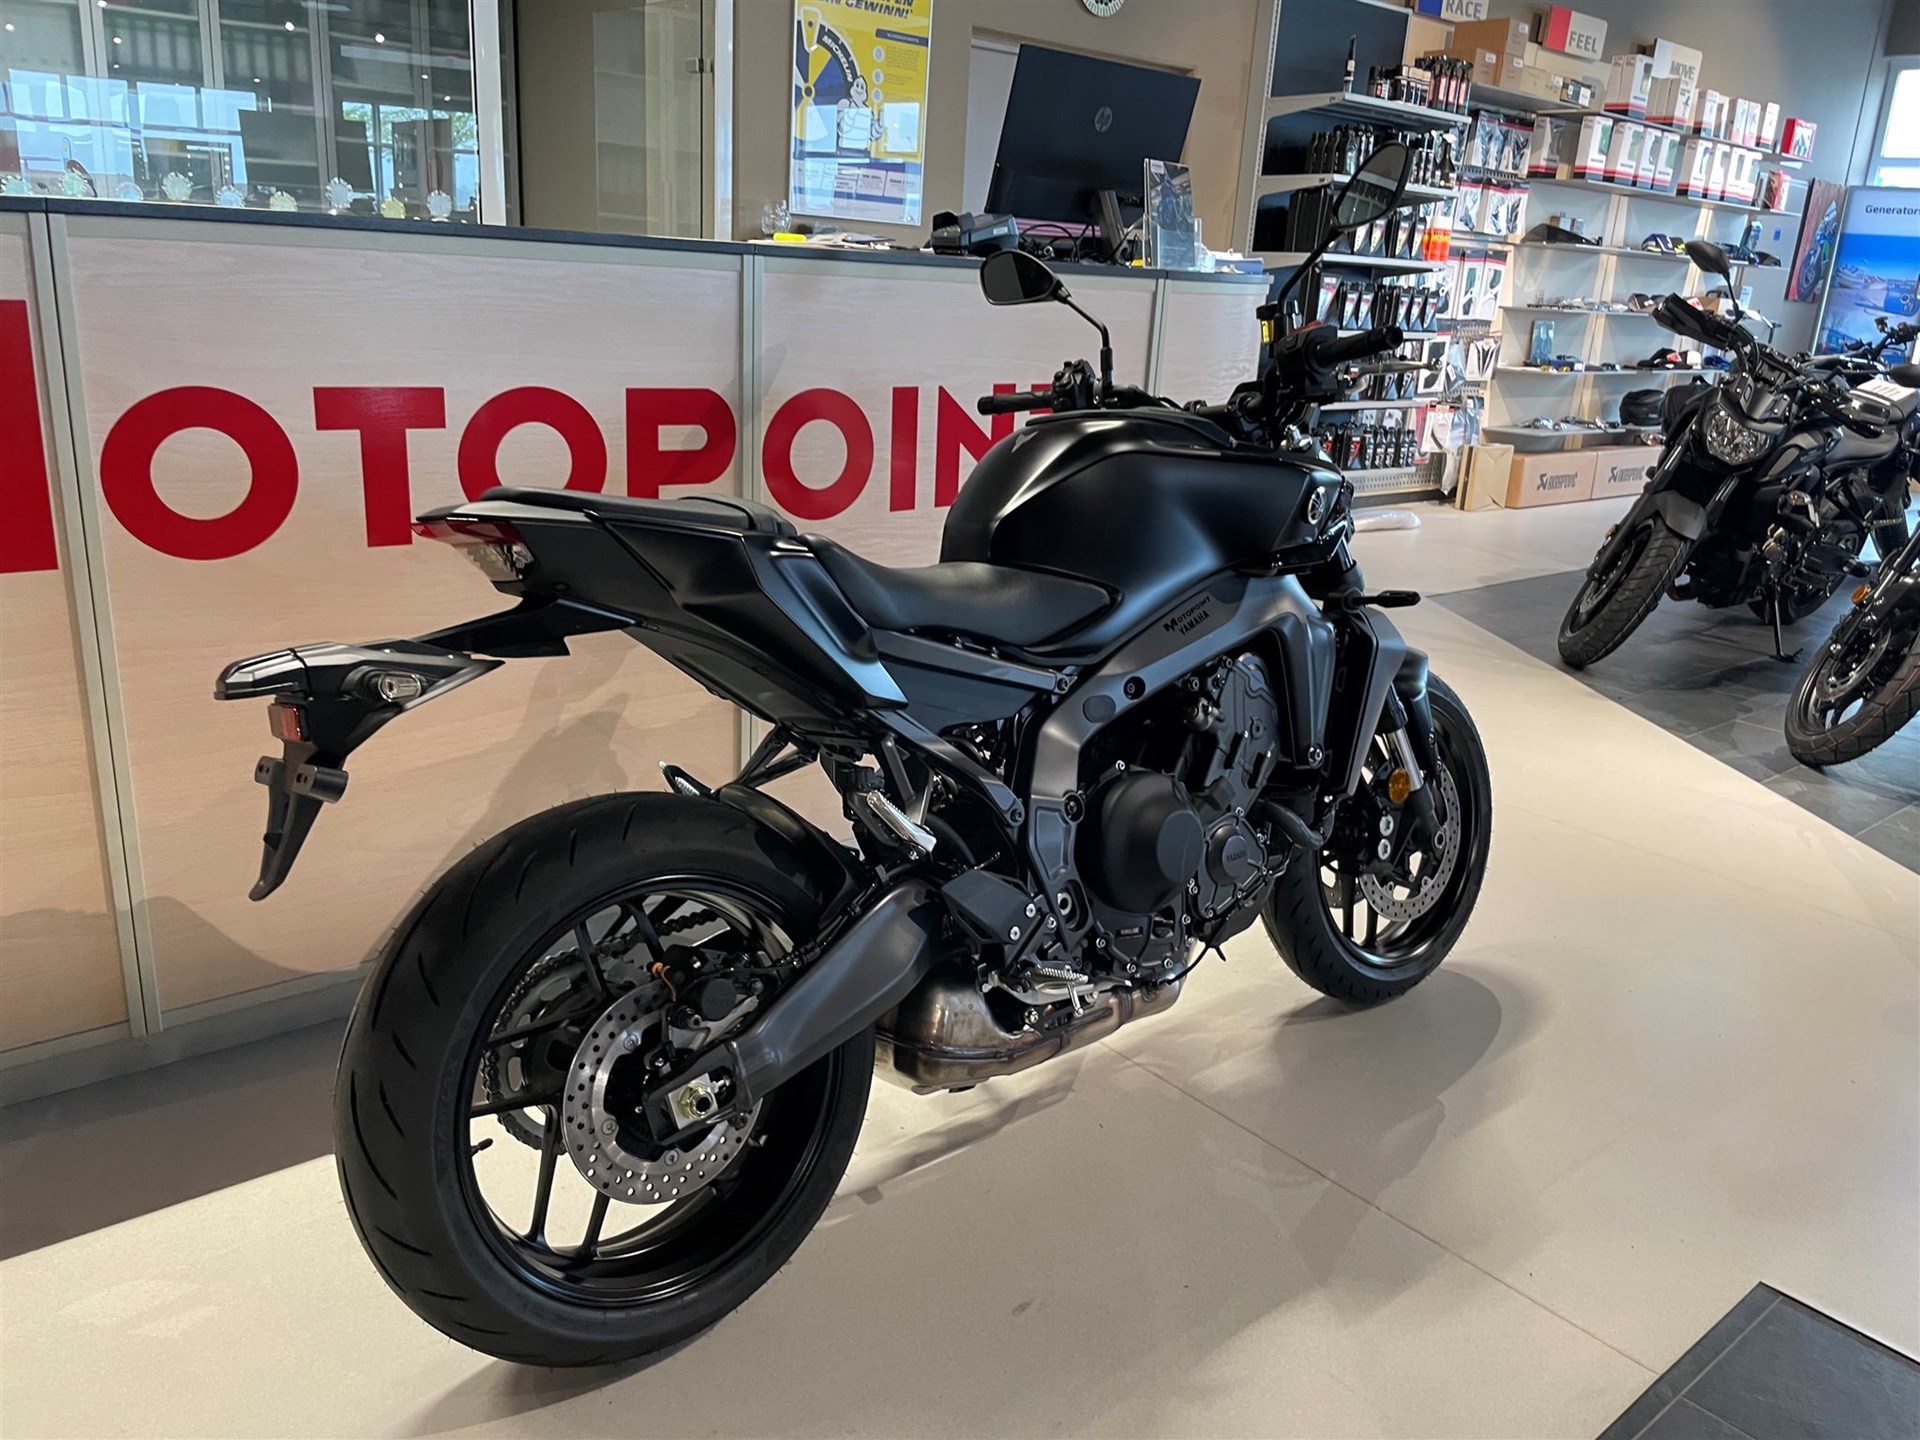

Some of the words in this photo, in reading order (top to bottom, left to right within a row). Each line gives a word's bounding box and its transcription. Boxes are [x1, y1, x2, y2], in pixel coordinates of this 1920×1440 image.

[1445, 0, 1482, 19] RACE
[1569, 31, 1598, 54] FEEL
[821, 34, 854, 82] MICHELIN
[1669, 60, 1695, 80] MOVE
[1163, 595, 1211, 632] MOTOPOINT
[1179, 610, 1210, 635] YAMAHA
